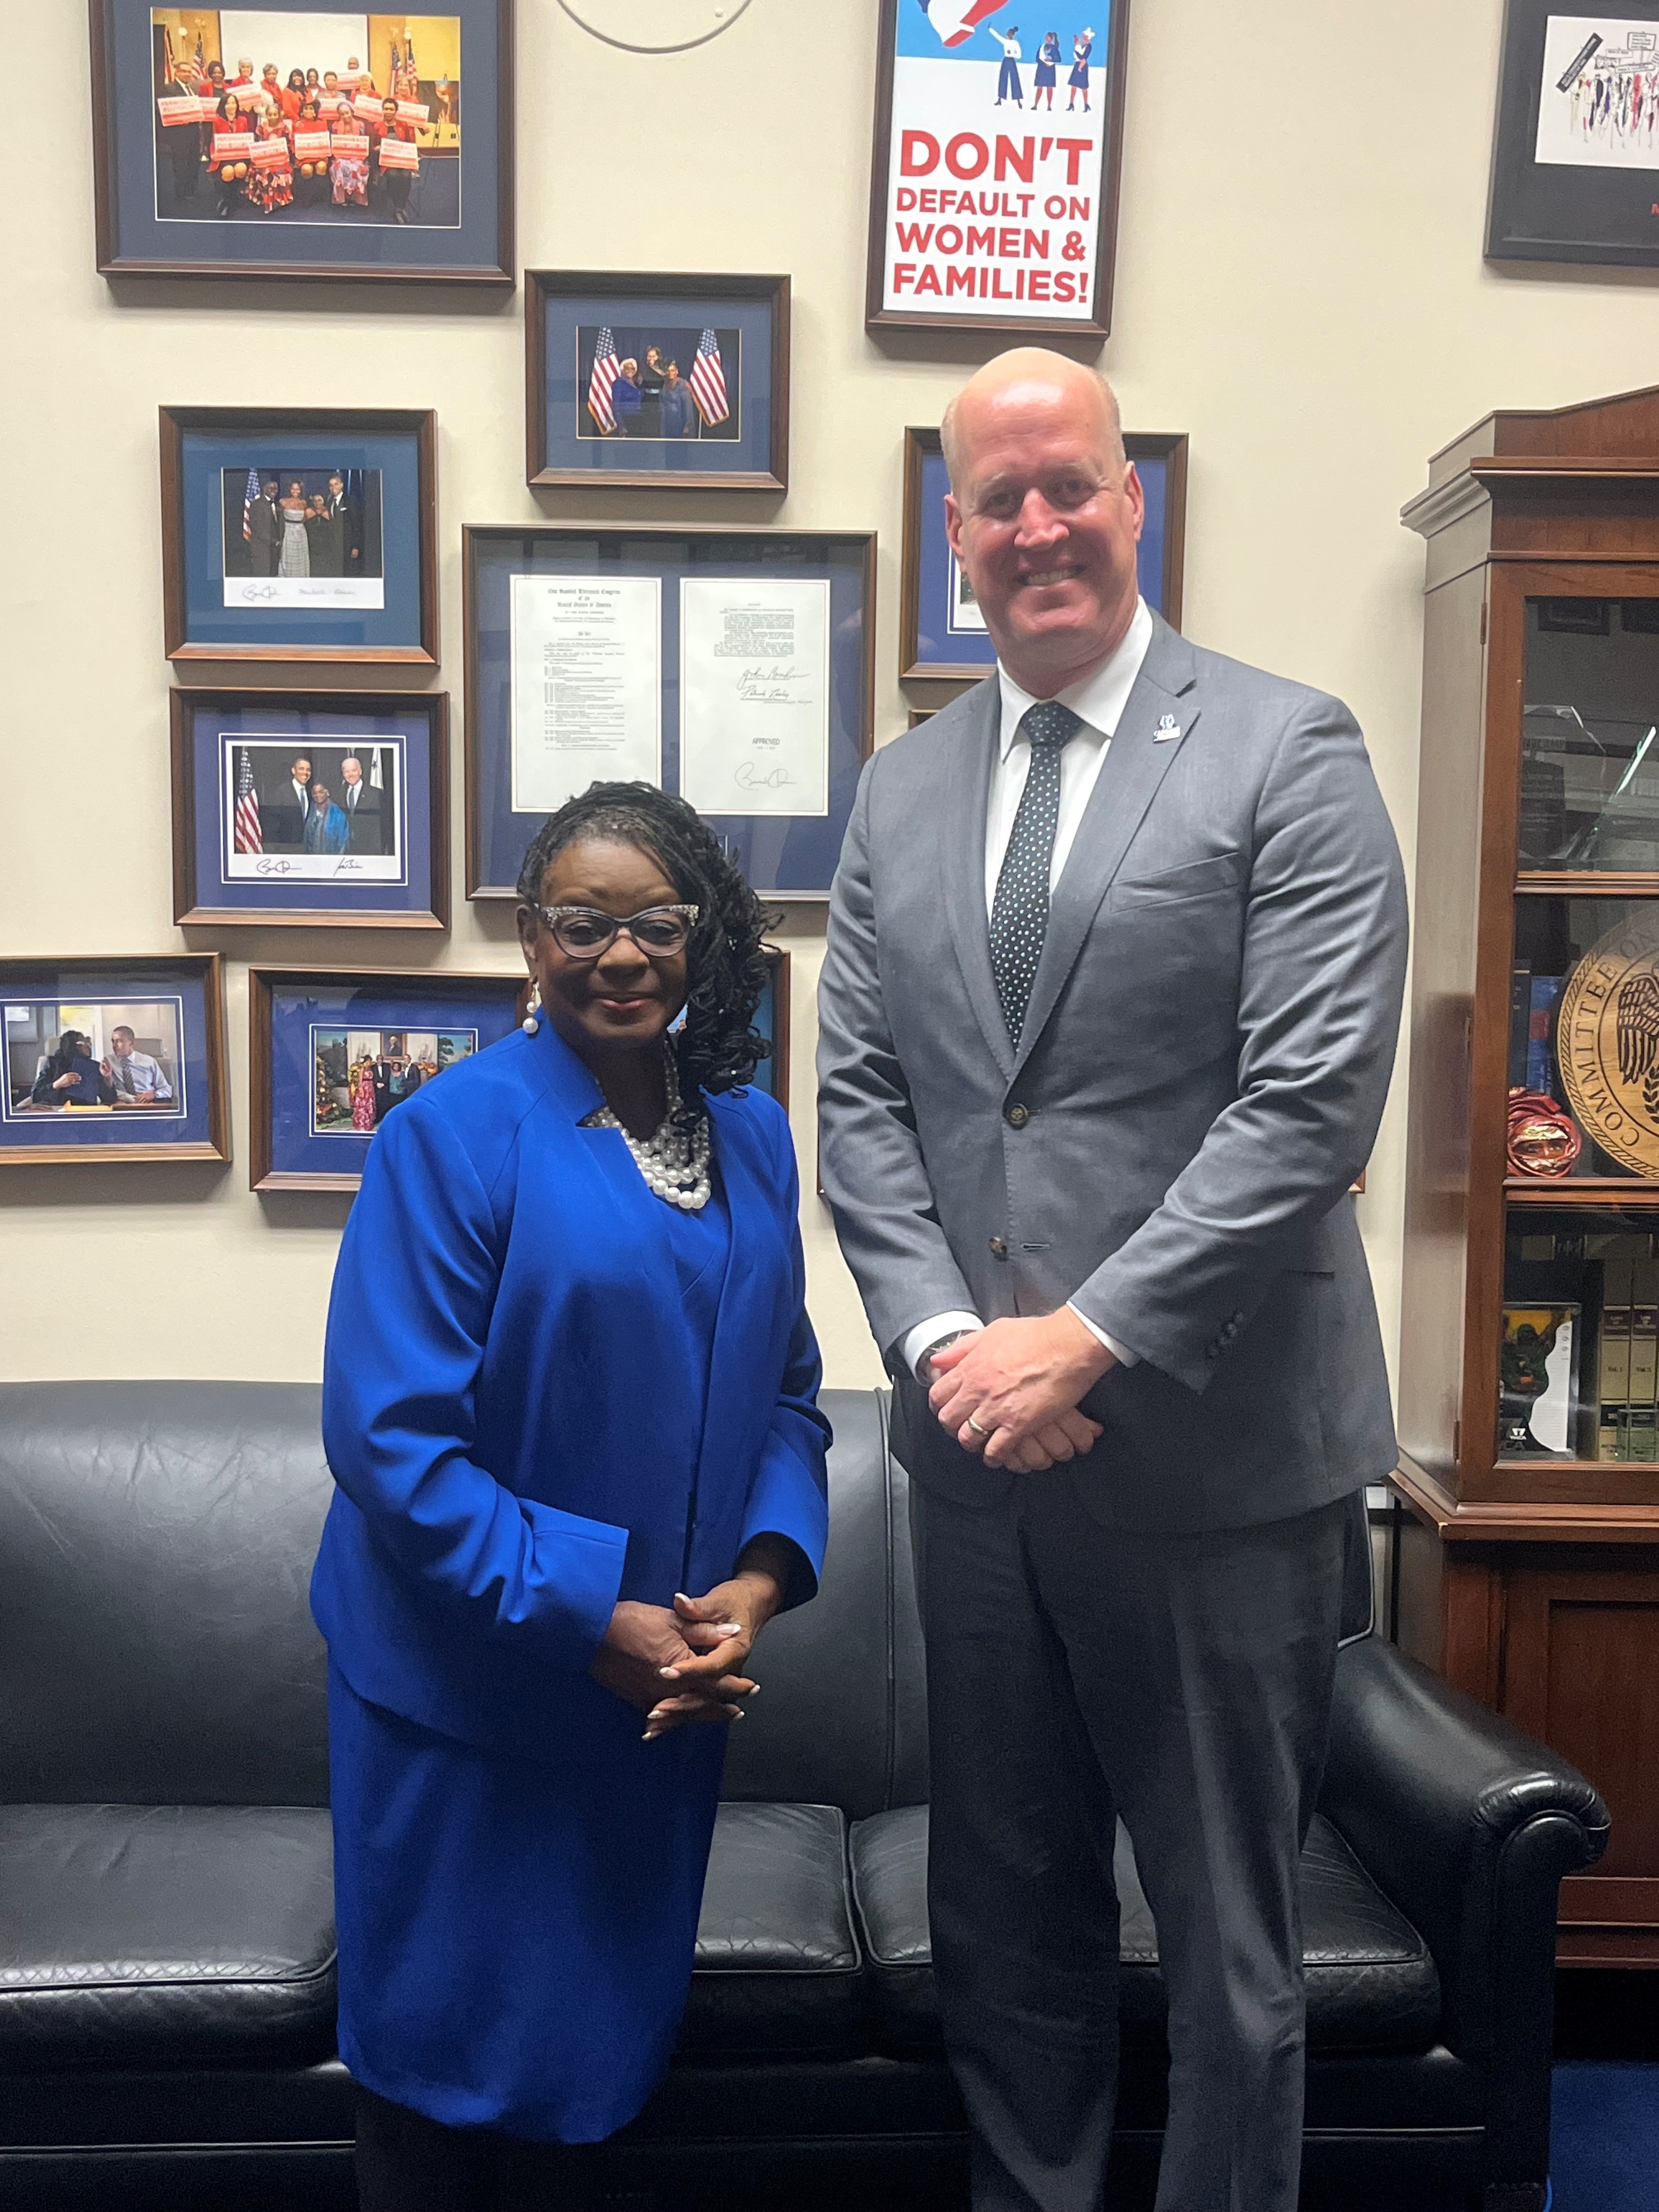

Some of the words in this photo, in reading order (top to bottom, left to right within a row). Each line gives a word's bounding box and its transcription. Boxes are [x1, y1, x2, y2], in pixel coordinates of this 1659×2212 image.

[900, 129, 1093, 186] DON'T
[896, 187, 1036, 218] DEFAULT
[1044, 195, 1090, 221] ON
[895, 222, 1050, 259] WOMEN
[1061, 230, 1086, 261] &
[893, 263, 1089, 303] FAMILIES!
[752, 737, 781, 746] APPROVED
[1575, 962, 1640, 1147] COMMITTEE
